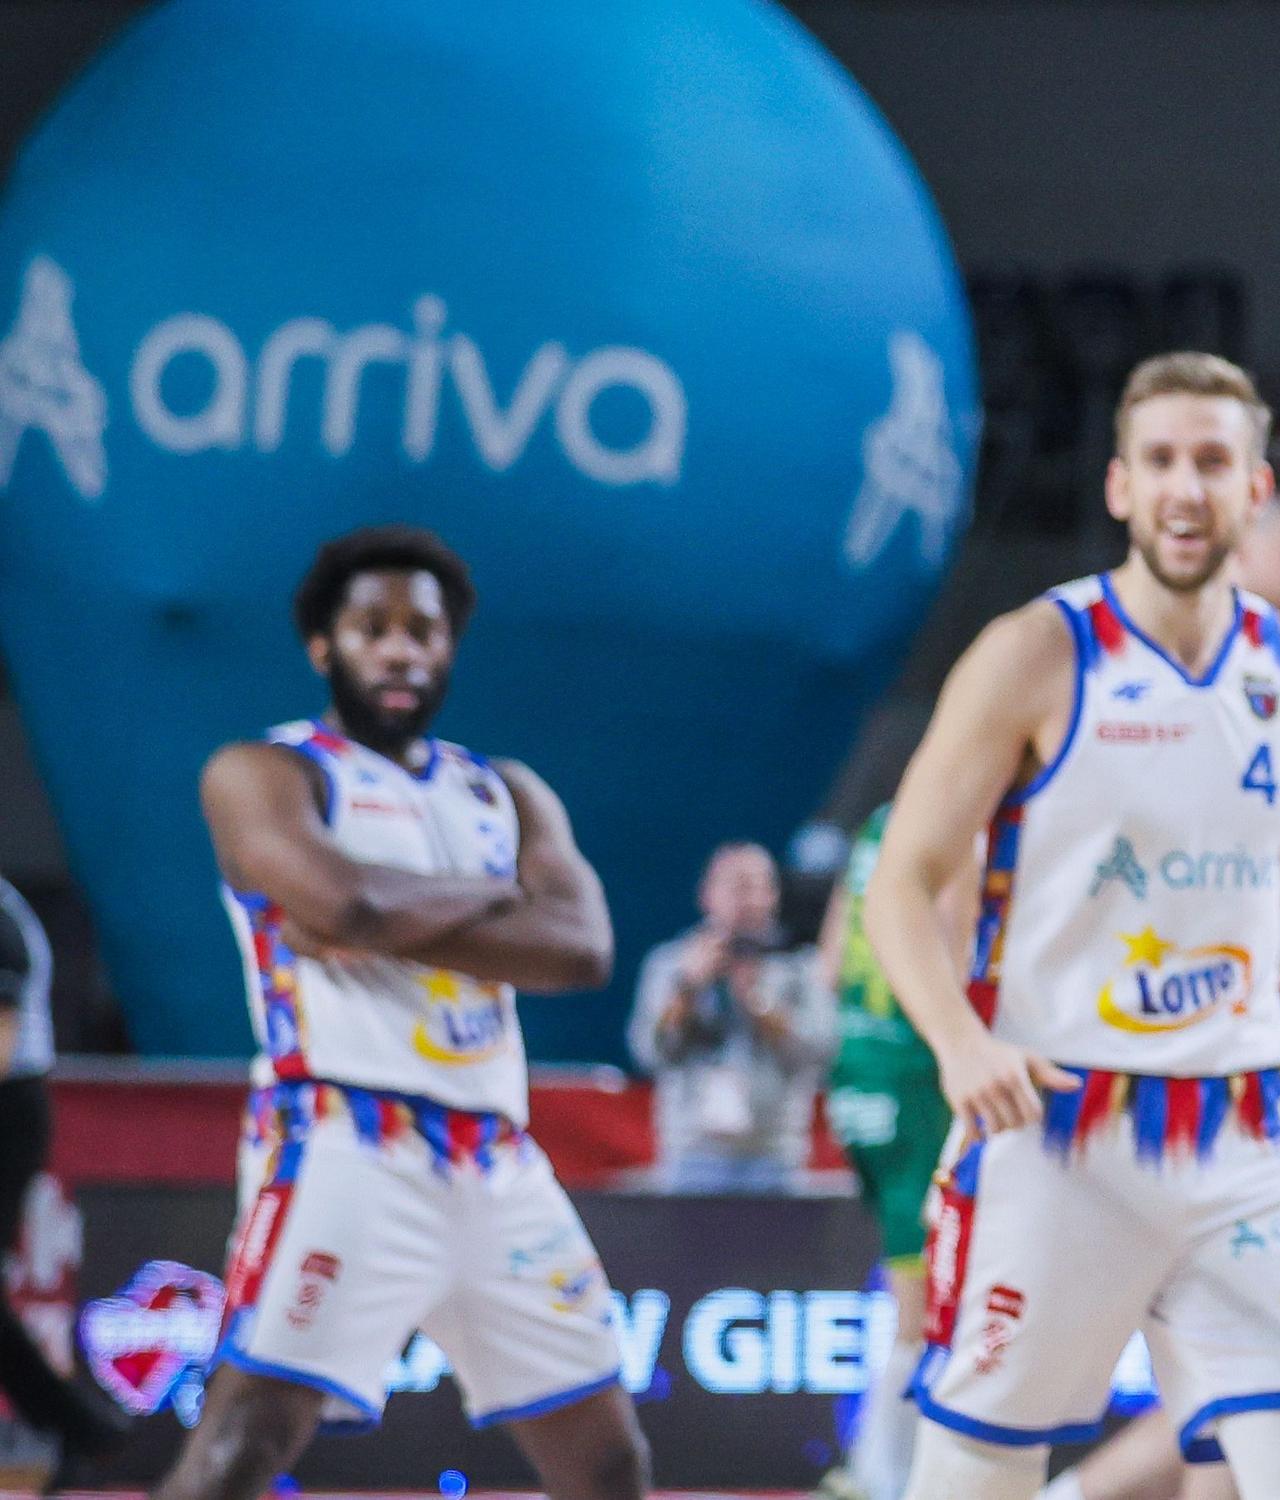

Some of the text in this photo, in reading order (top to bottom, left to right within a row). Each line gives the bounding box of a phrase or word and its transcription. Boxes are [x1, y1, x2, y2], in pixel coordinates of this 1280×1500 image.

[131, 292, 690, 487] arriva
[1242, 744, 1278, 804] 4
[1136, 962, 1235, 1014] LOTTO
